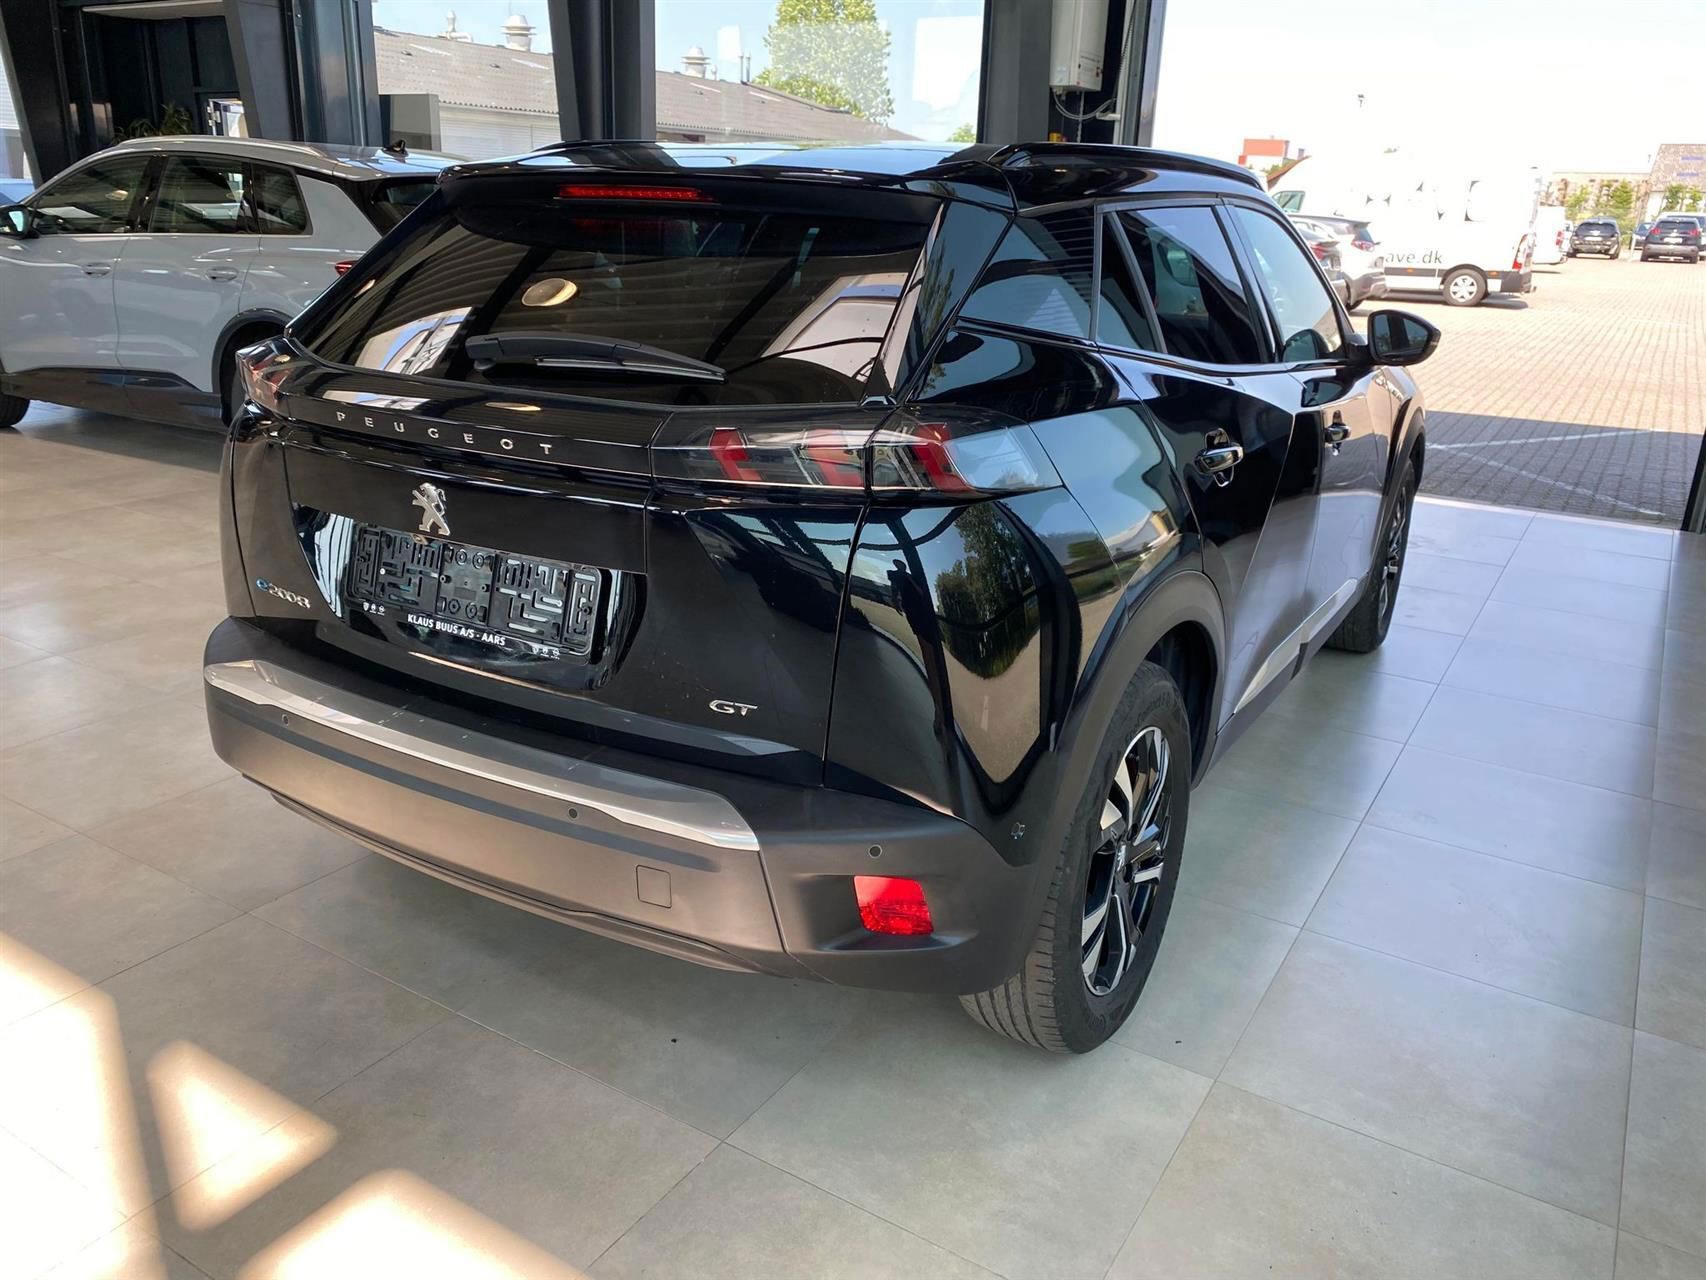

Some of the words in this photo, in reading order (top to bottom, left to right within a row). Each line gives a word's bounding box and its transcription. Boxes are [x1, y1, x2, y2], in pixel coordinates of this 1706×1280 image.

[335, 411, 553, 455] PEUGEOT
[407, 613, 434, 628] KLAUS
[435, 621, 459, 634] BUUS
[459, 627, 475, 639] A/S
[481, 632, 506, 647] AARS
[709, 699, 759, 717] GT
